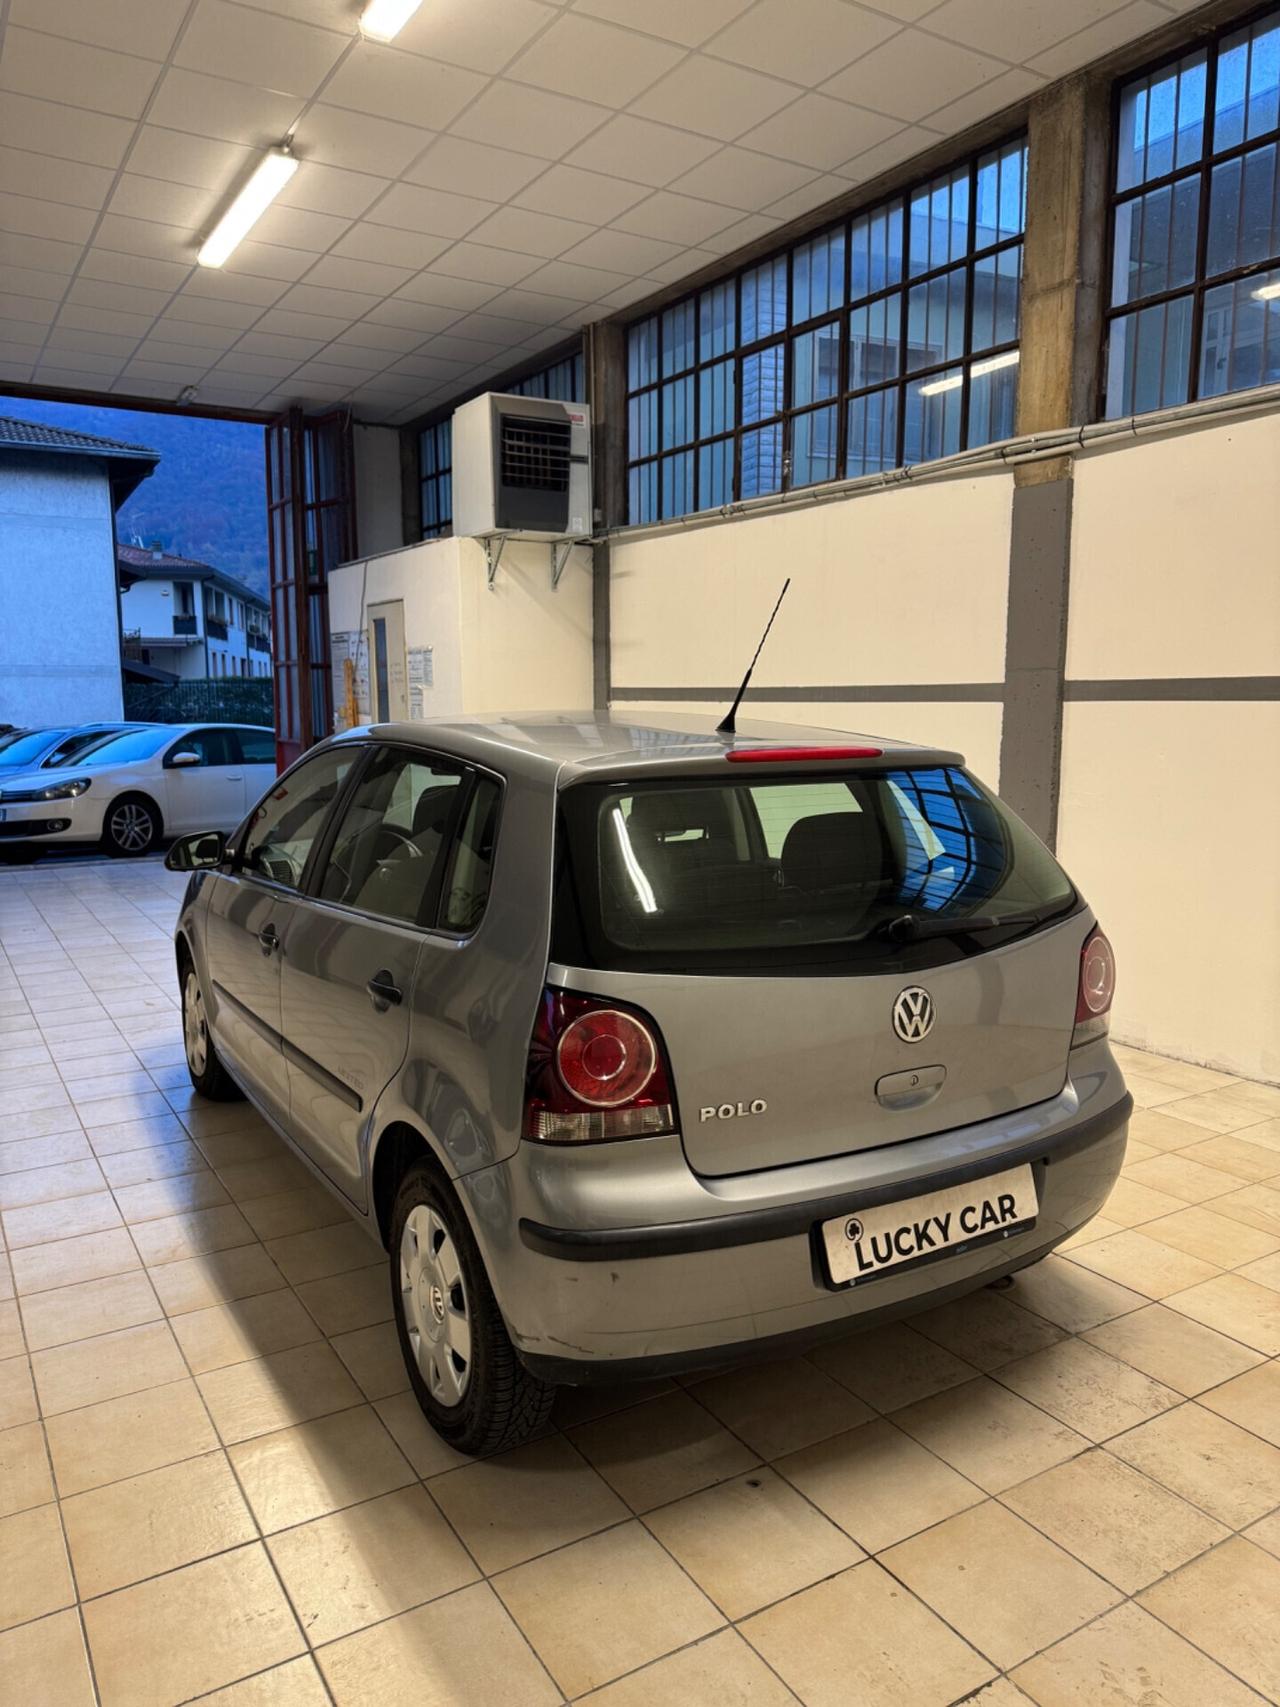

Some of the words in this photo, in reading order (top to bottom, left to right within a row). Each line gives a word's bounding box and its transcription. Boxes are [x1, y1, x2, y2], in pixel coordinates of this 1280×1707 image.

[700, 1099, 768, 1122] POLO
[854, 1212, 952, 1271] LUCKY
[959, 1194, 1017, 1234] CAR
